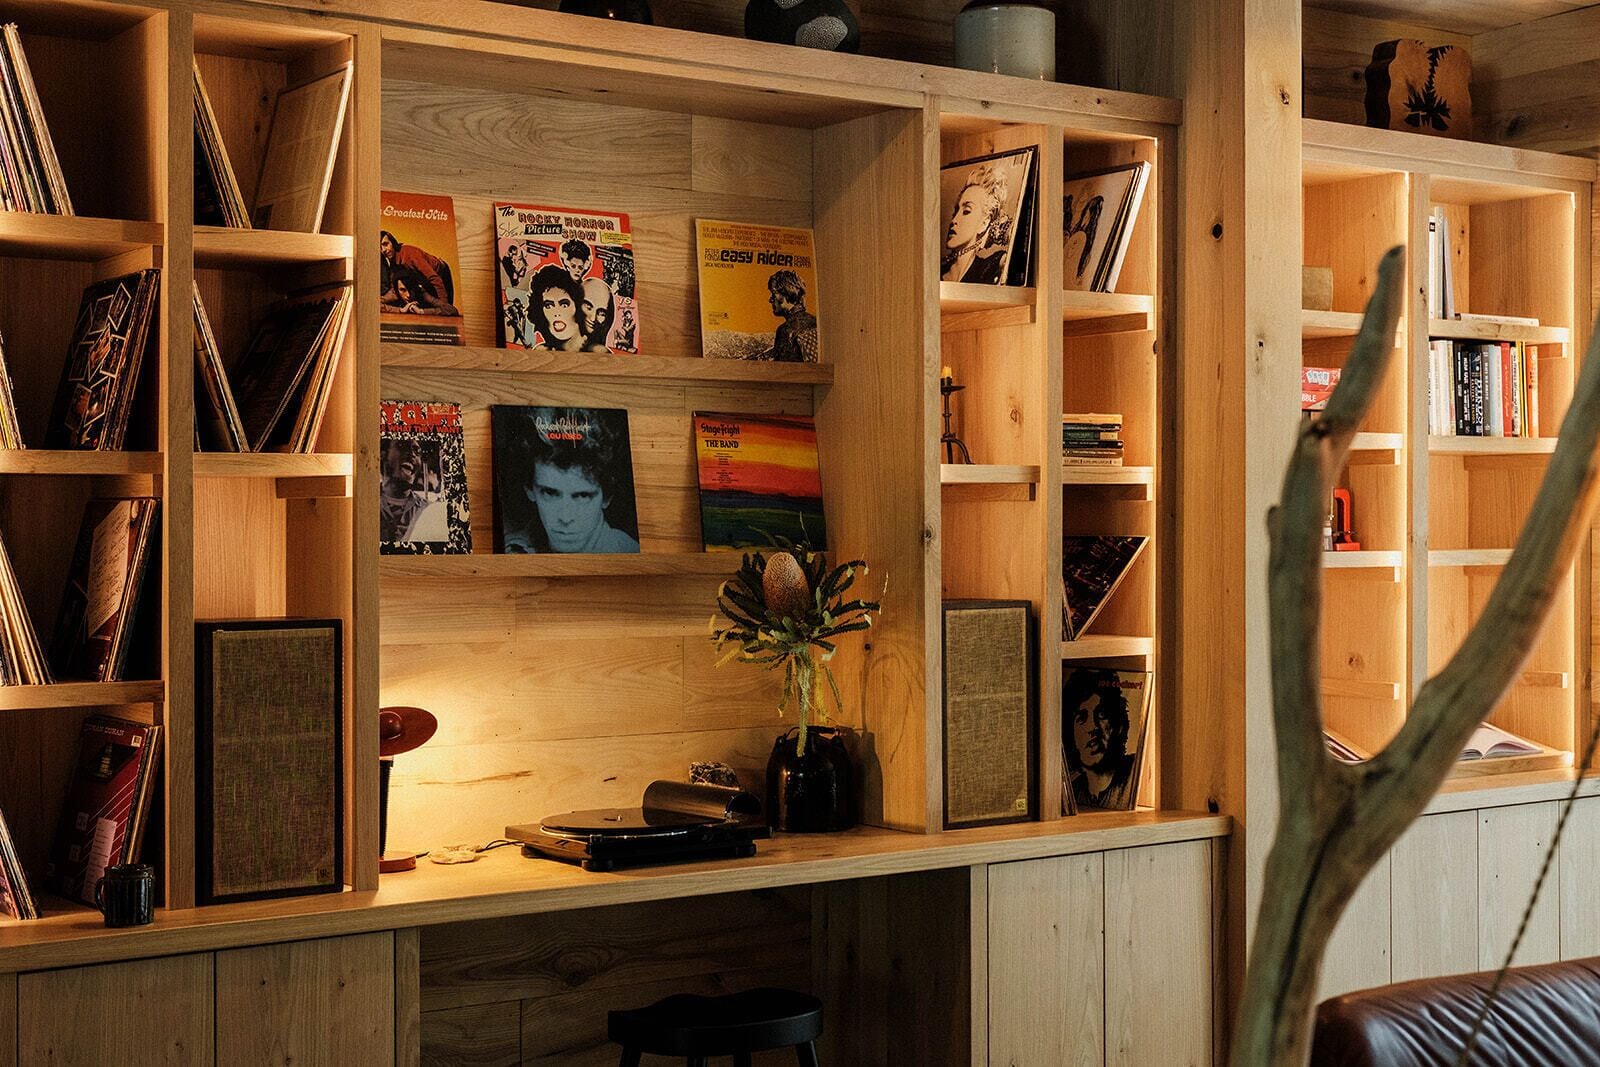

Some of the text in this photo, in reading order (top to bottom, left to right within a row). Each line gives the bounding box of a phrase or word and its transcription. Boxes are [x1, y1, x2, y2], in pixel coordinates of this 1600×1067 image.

[383, 205, 448, 221] Greatest Hits
[498, 205, 614, 231] The ROCKY HORROR
[525, 224, 561, 234] Picture
[561, 229, 597, 241] SHOW
[545, 432, 560, 440] LOU
[705, 440, 739, 449] THE BAND
